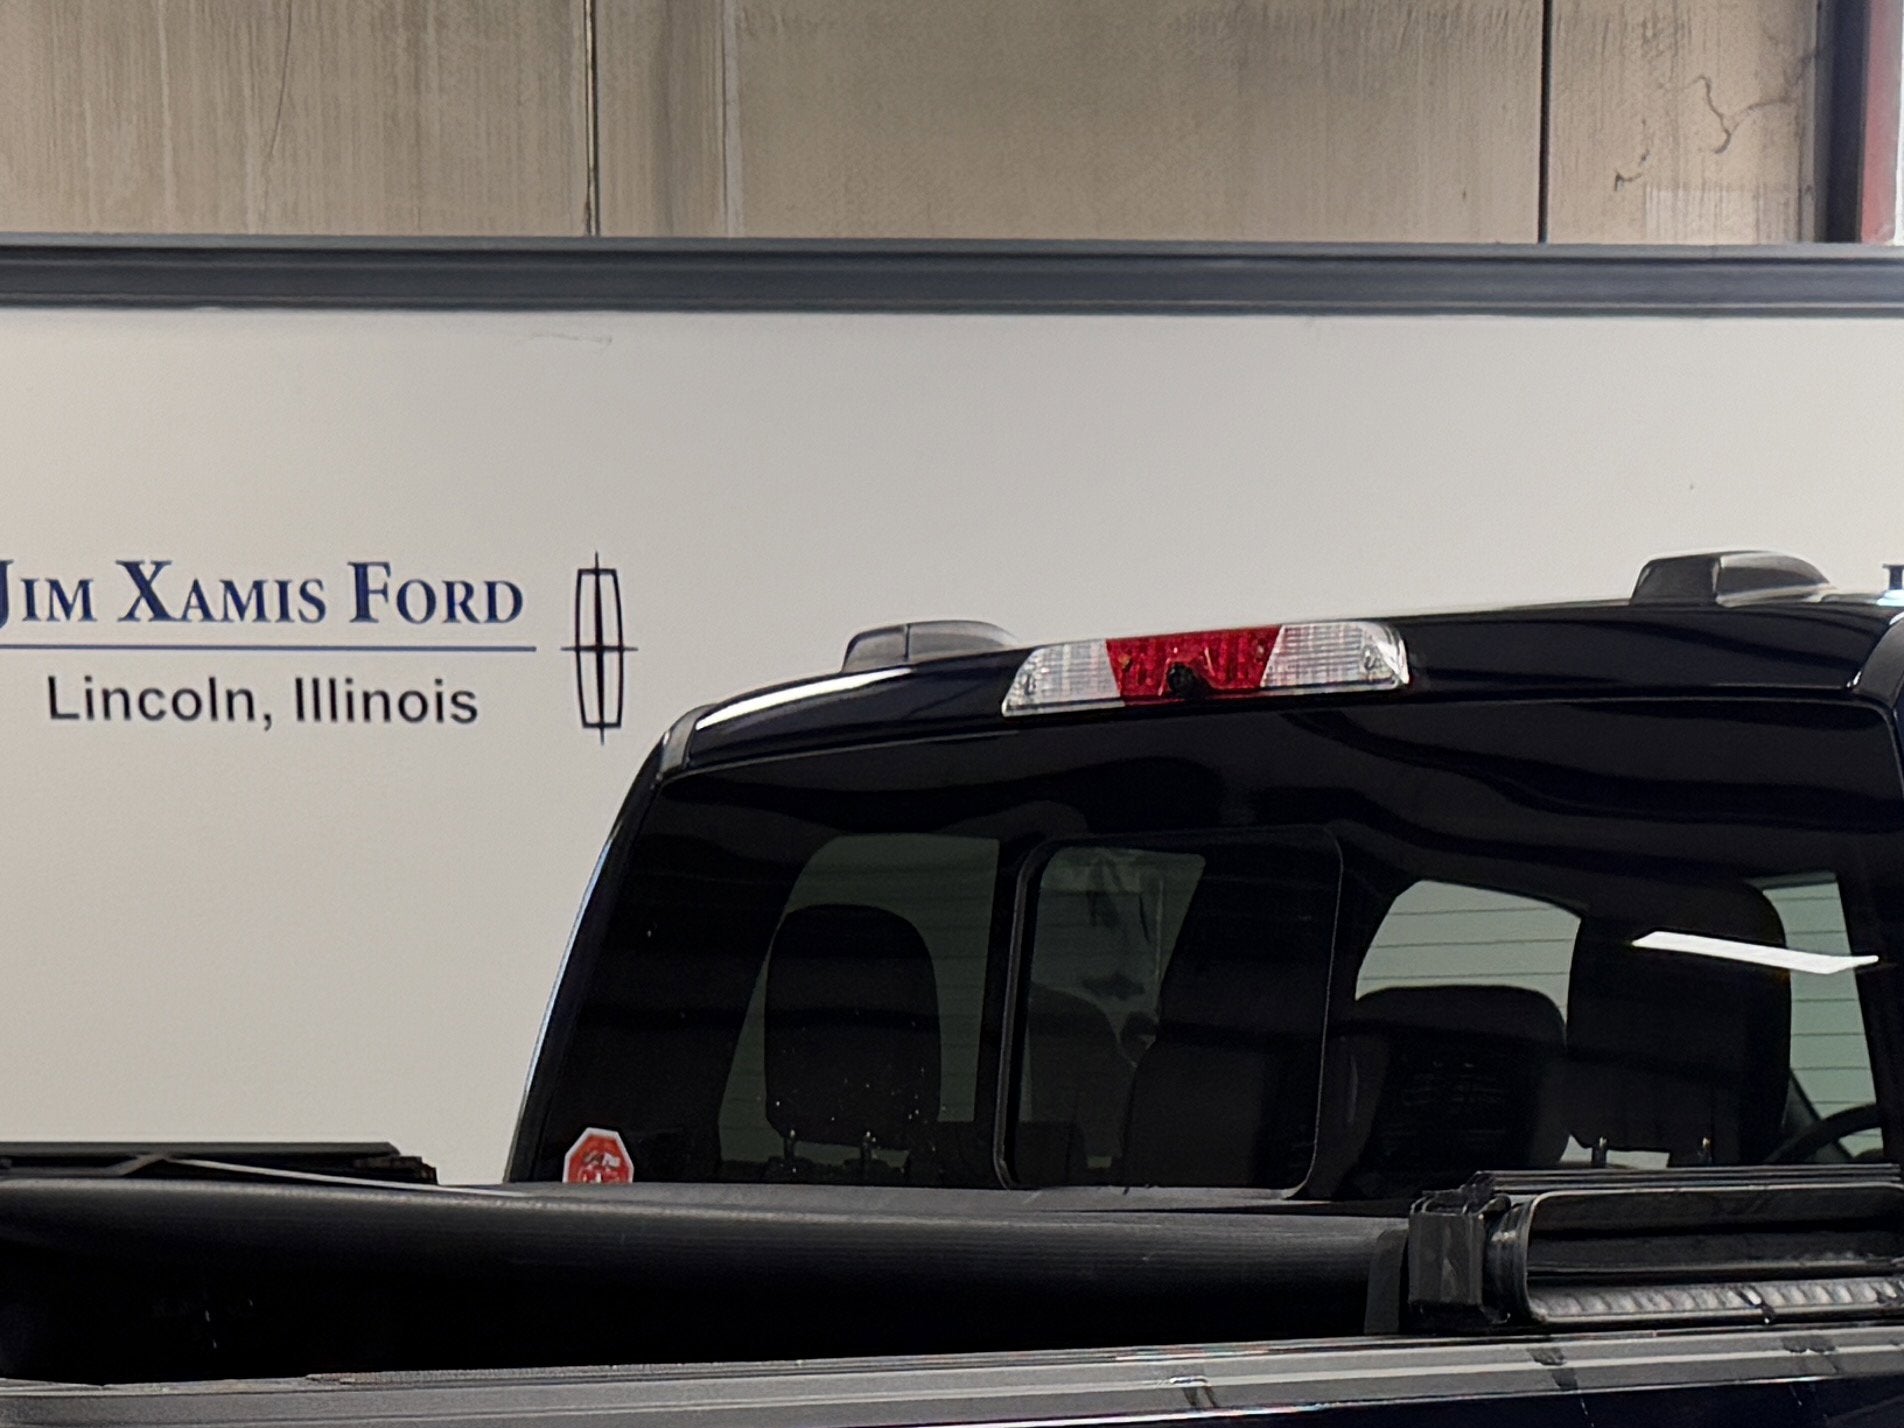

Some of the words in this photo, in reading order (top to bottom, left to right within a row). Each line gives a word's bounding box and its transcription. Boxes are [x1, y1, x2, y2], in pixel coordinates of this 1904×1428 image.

[115, 558, 329, 625] XAMIS
[346, 559, 526, 626] FORD
[46, 675, 274, 731] Lincoln,
[294, 675, 480, 726] Illinois
